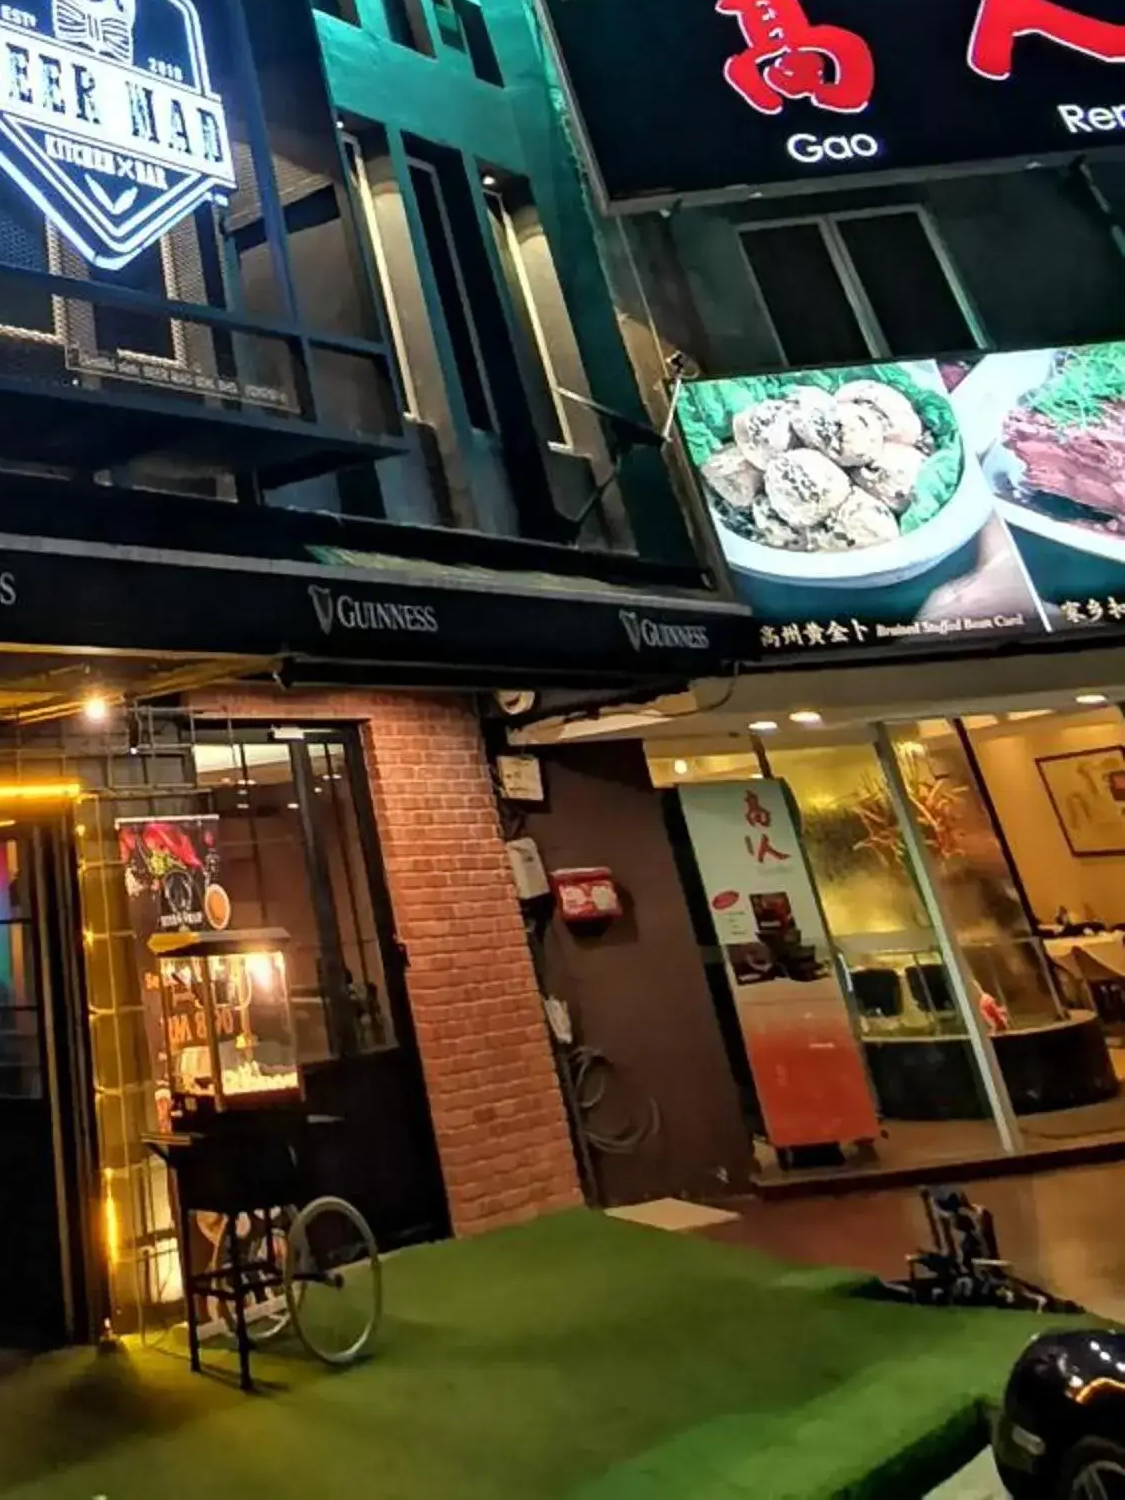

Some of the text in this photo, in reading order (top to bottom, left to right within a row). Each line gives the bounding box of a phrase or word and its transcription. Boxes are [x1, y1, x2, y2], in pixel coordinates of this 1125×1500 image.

[125, 81, 225, 163] MAD
[786, 131, 879, 164] Gao
[337, 598, 438, 632] GUINNESS
[641, 618, 709, 649] GUINNESS
